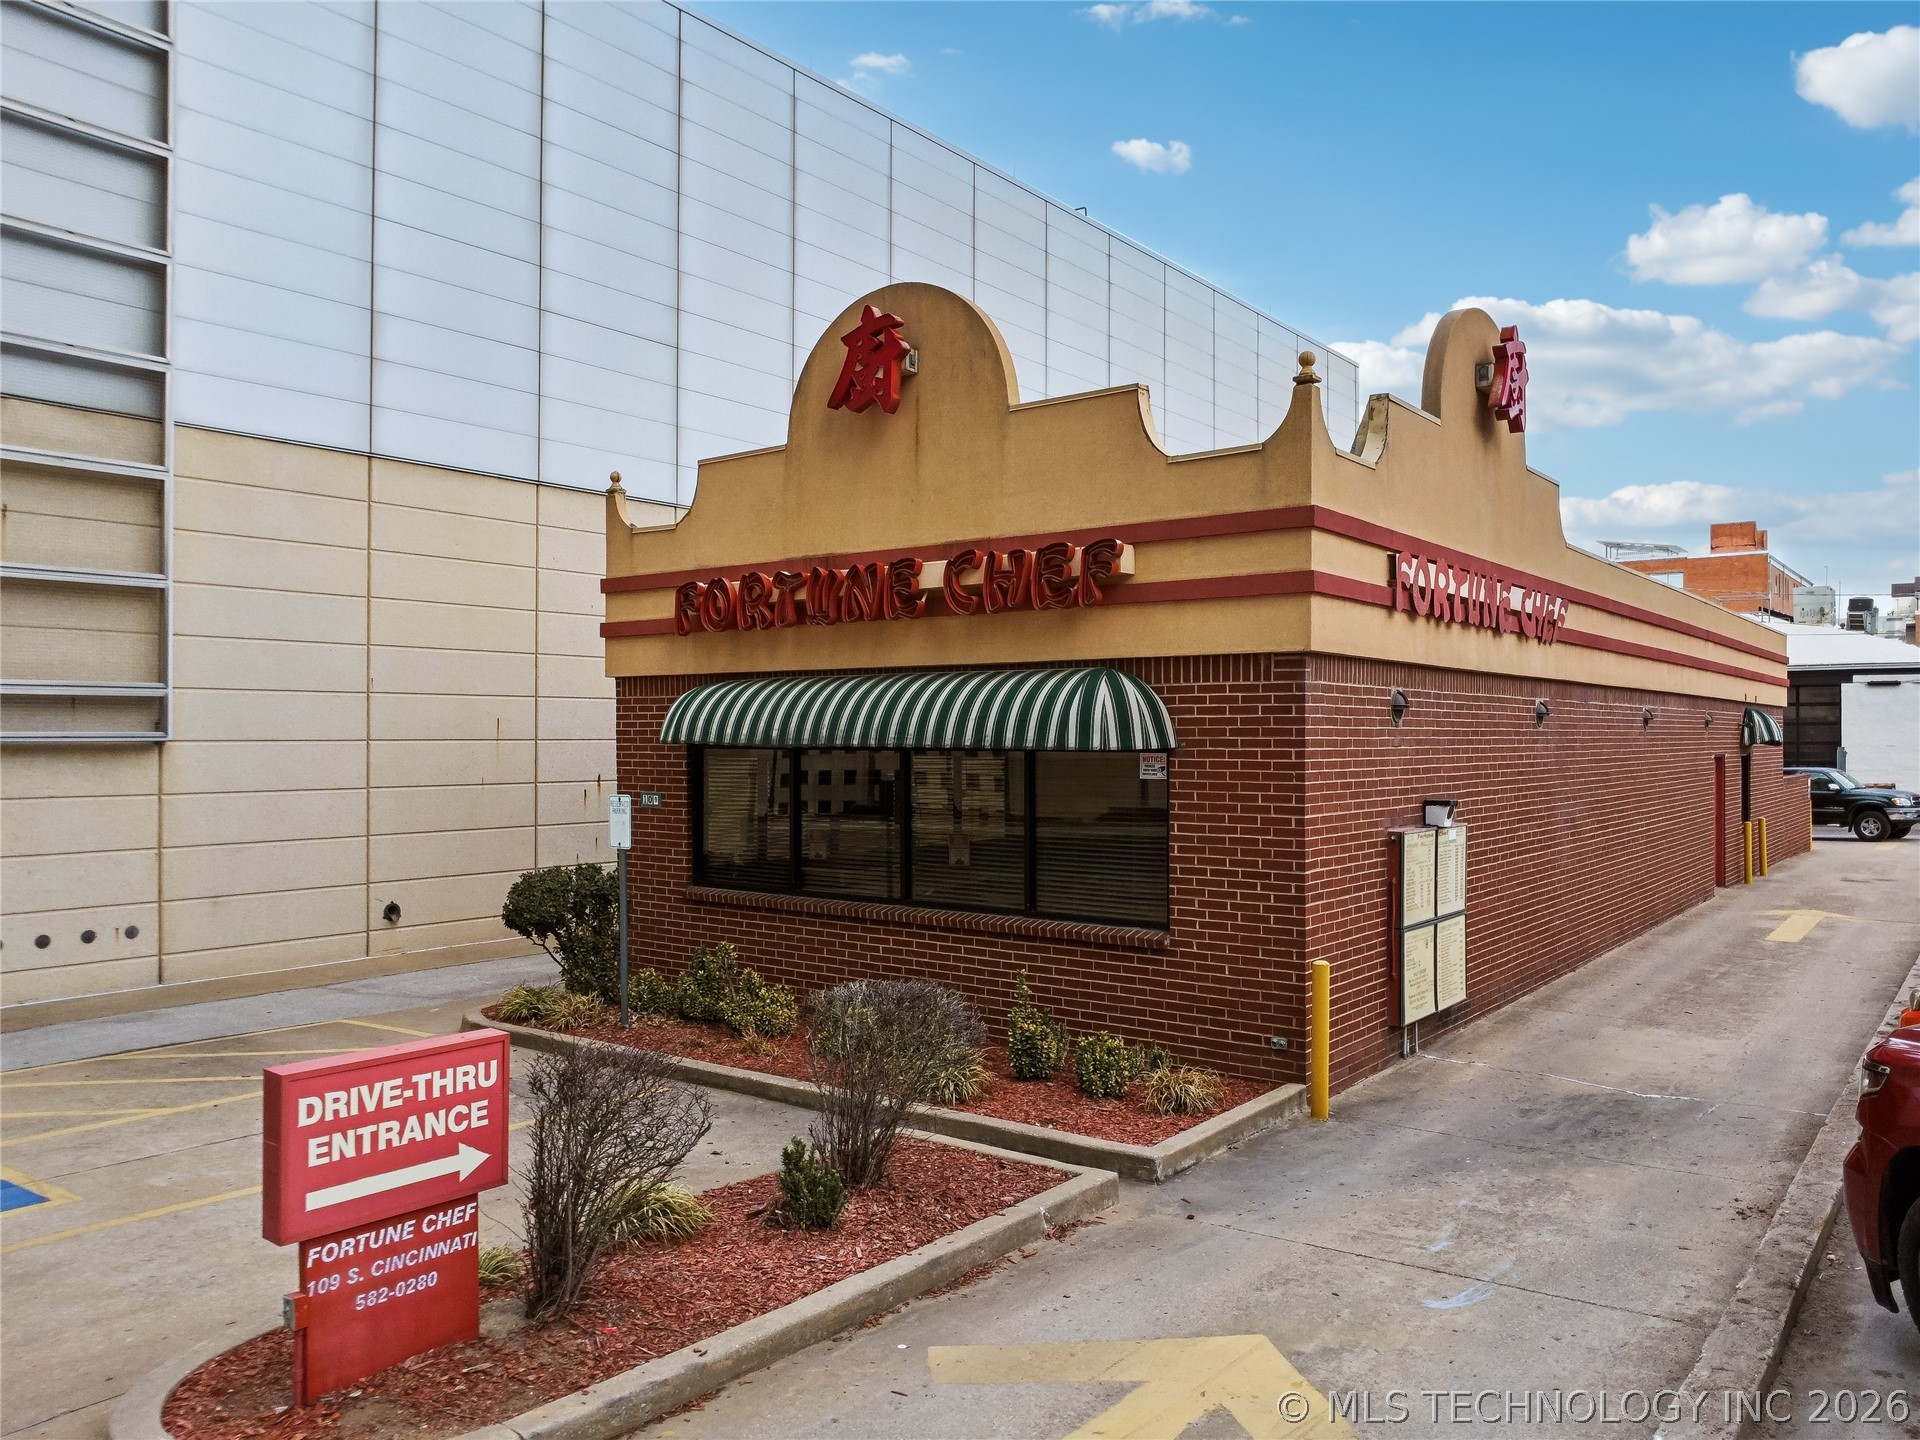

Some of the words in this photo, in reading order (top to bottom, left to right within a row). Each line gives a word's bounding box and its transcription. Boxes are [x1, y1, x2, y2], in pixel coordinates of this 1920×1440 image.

[674, 556, 928, 637] FORTUNE
[943, 538, 1124, 616] CHEF
[1396, 551, 1518, 634] FORTUNE
[1520, 585, 1569, 644] CHEF
[297, 1059, 498, 1128] DRIVE-THRU
[308, 1099, 489, 1168] ENTRANCE
[306, 1219, 416, 1269] FORTUNE
[422, 1202, 477, 1234] CHEF
[307, 1273, 341, 1298] 109
[346, 1267, 364, 1285] S.
[371, 1231, 477, 1277] CINCINNATI
[355, 1271, 438, 1311] 582-0280
